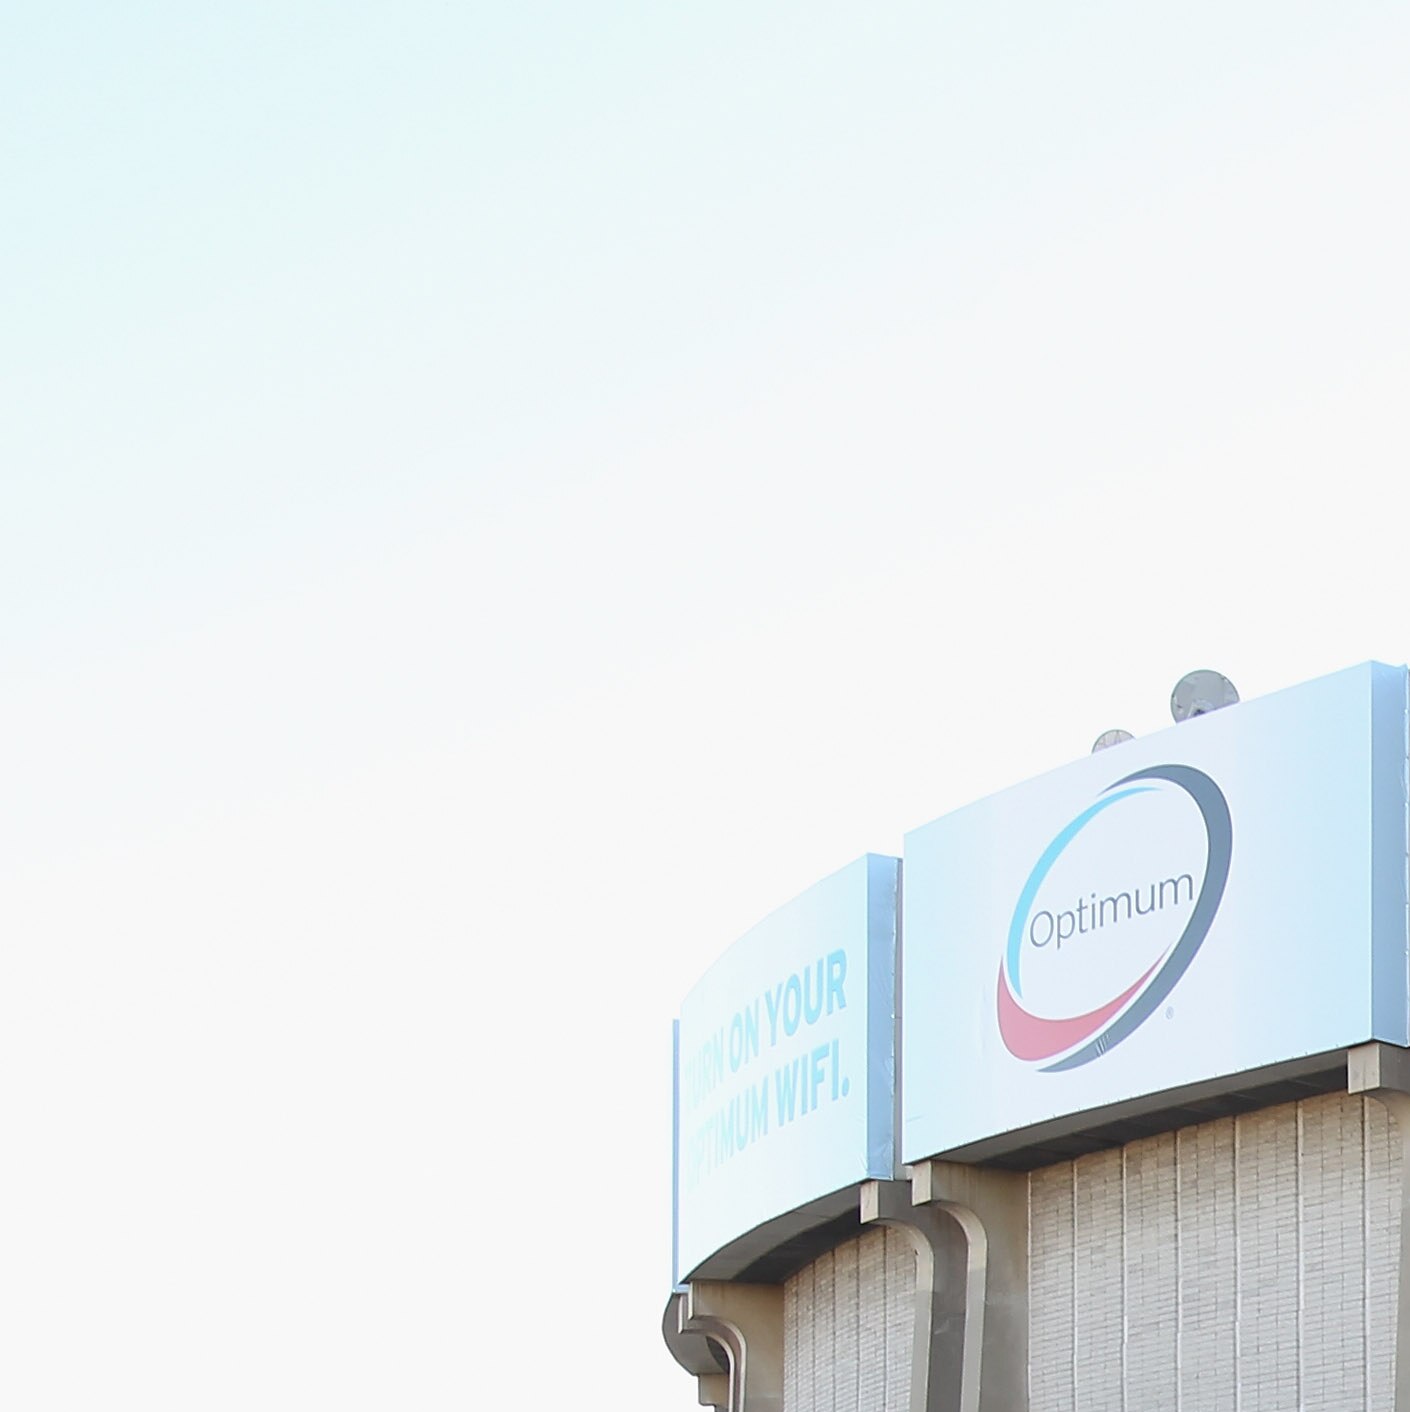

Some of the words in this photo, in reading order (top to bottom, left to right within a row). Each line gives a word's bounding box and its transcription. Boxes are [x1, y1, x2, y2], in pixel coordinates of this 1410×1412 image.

[1030, 874, 1193, 950] Optimum
[729, 998, 760, 1074] ON
[765, 949, 847, 1047] YOUR
[775, 1038, 850, 1128] WIFI.
